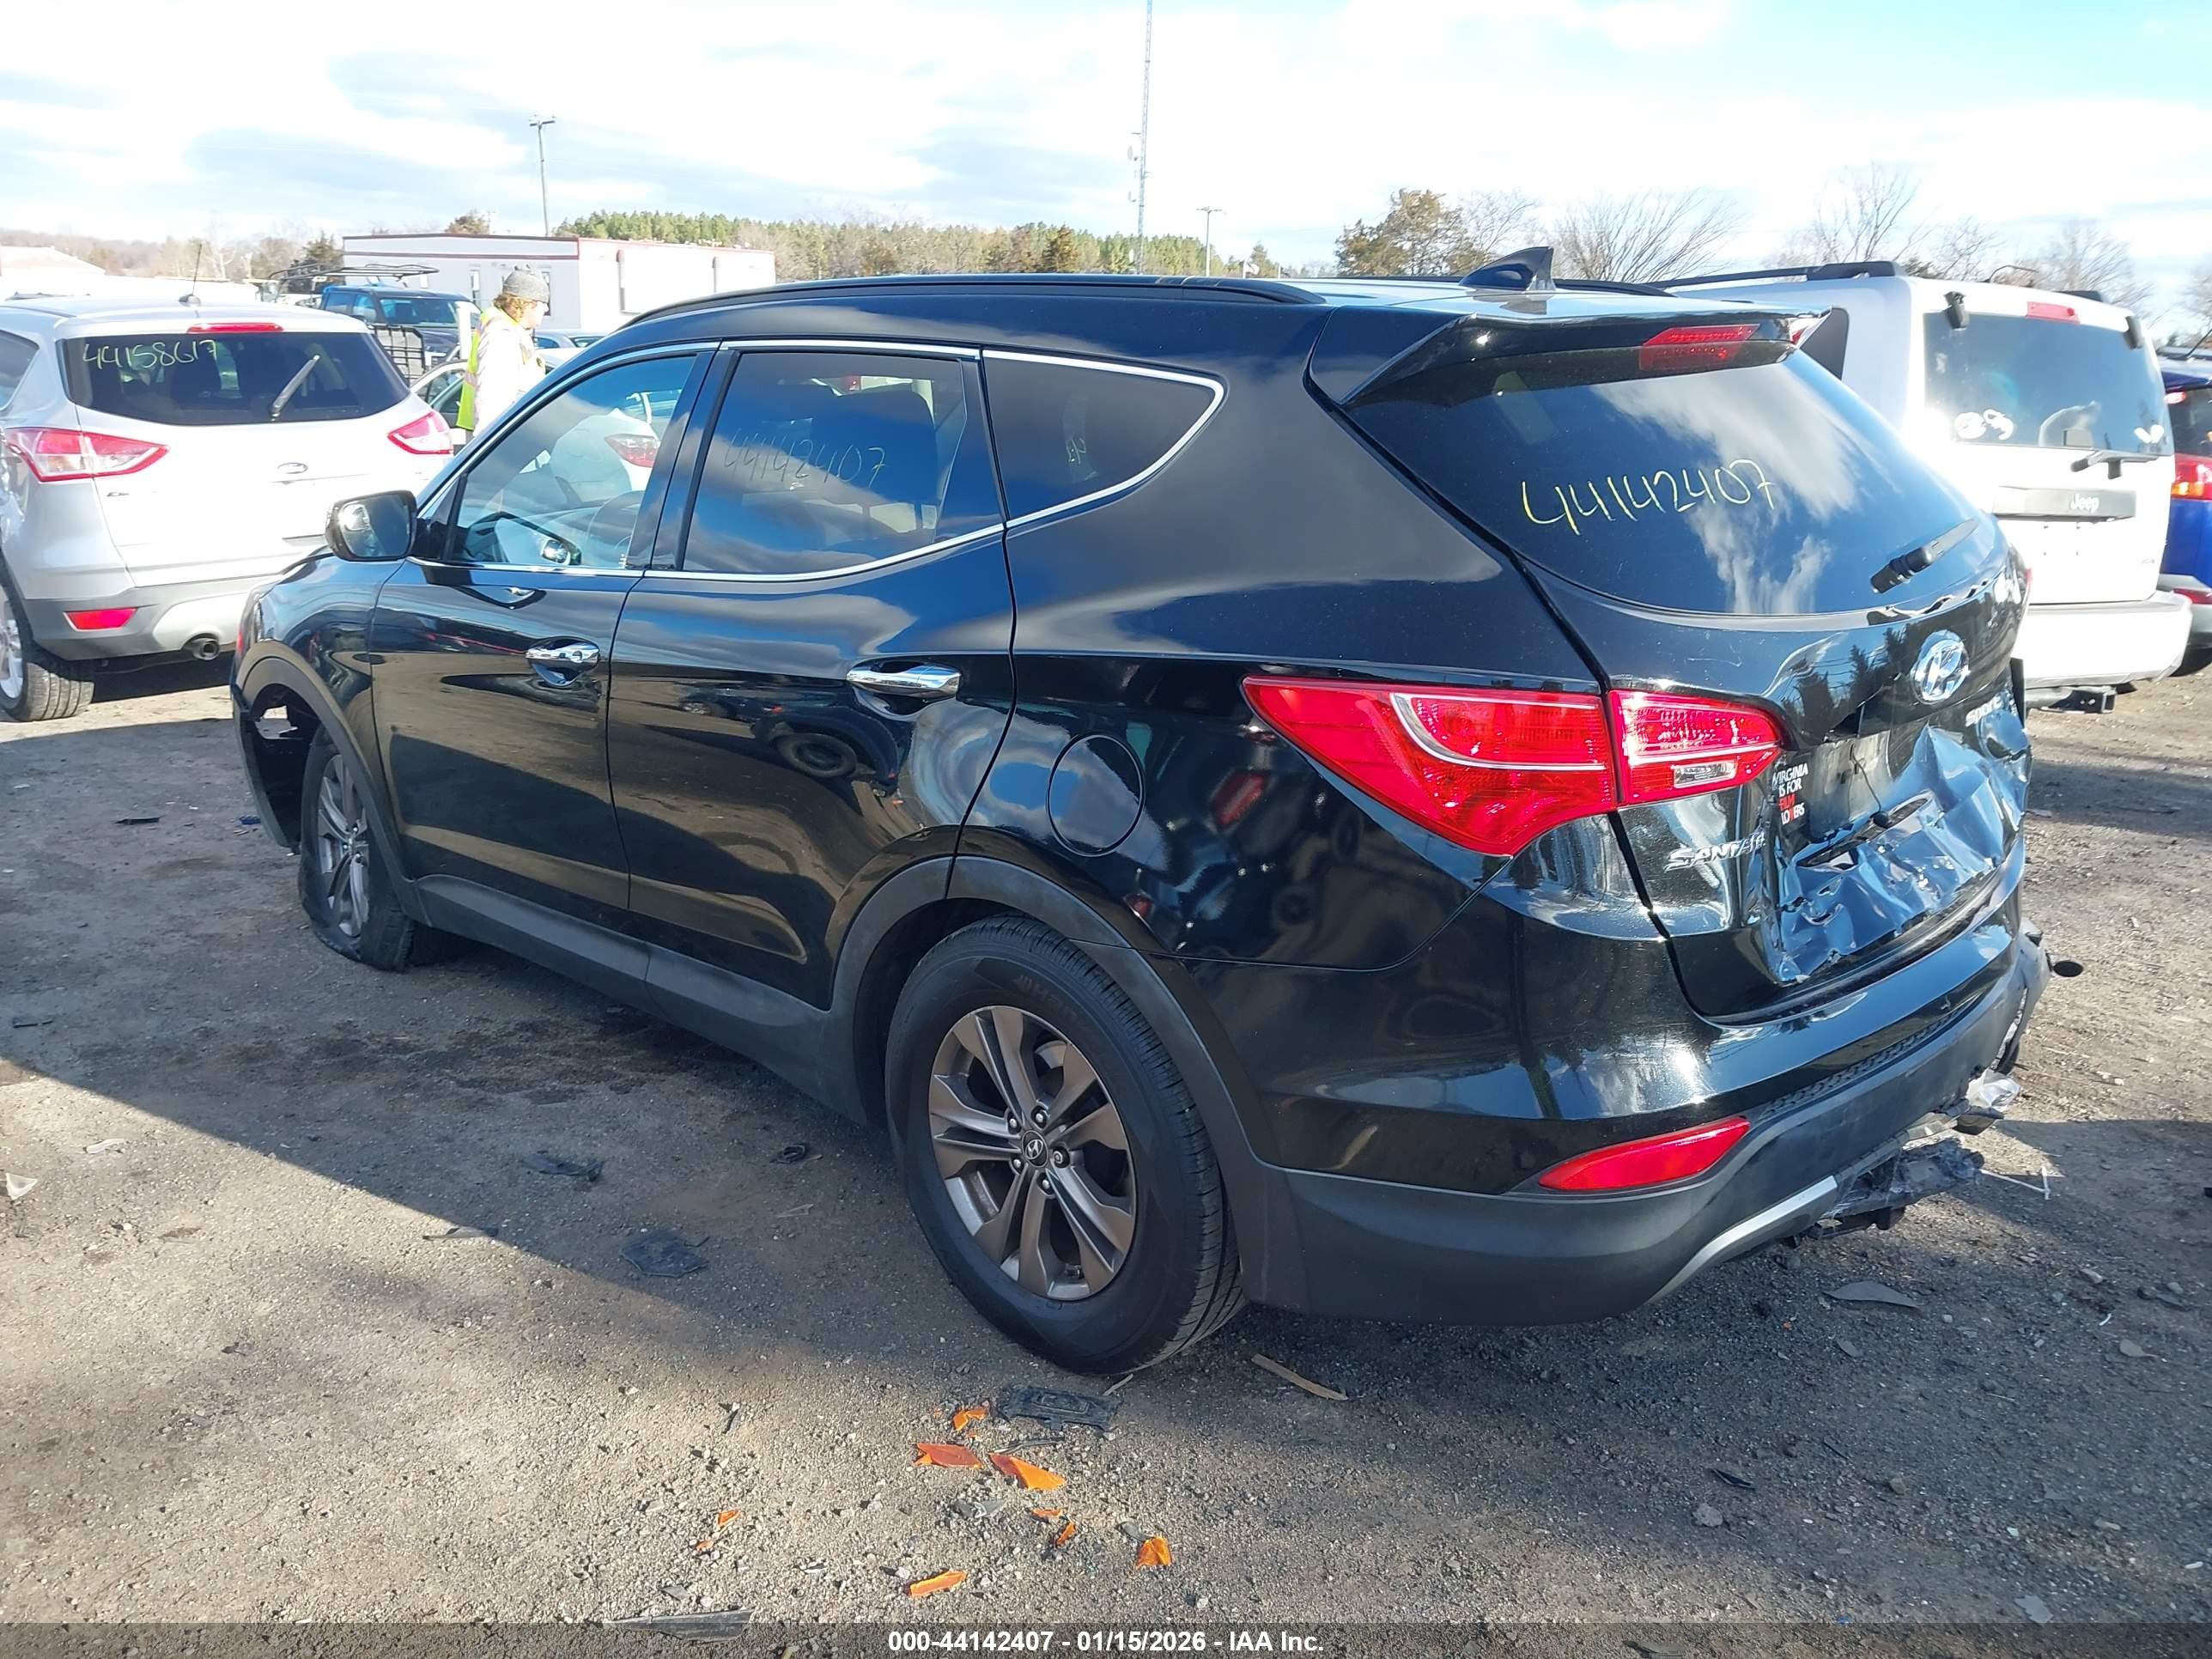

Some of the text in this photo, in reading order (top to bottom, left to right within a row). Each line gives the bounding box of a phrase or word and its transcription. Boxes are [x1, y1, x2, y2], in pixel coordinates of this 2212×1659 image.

[82, 339, 217, 369] 44158617
[723, 429, 886, 489] 44142407
[1521, 459, 1775, 536] 44142407
[2069, 493, 2100, 514] Jeep
[1773, 763, 1808, 785] VIRGINIA
[1778, 778, 1802, 797] IS FOR
